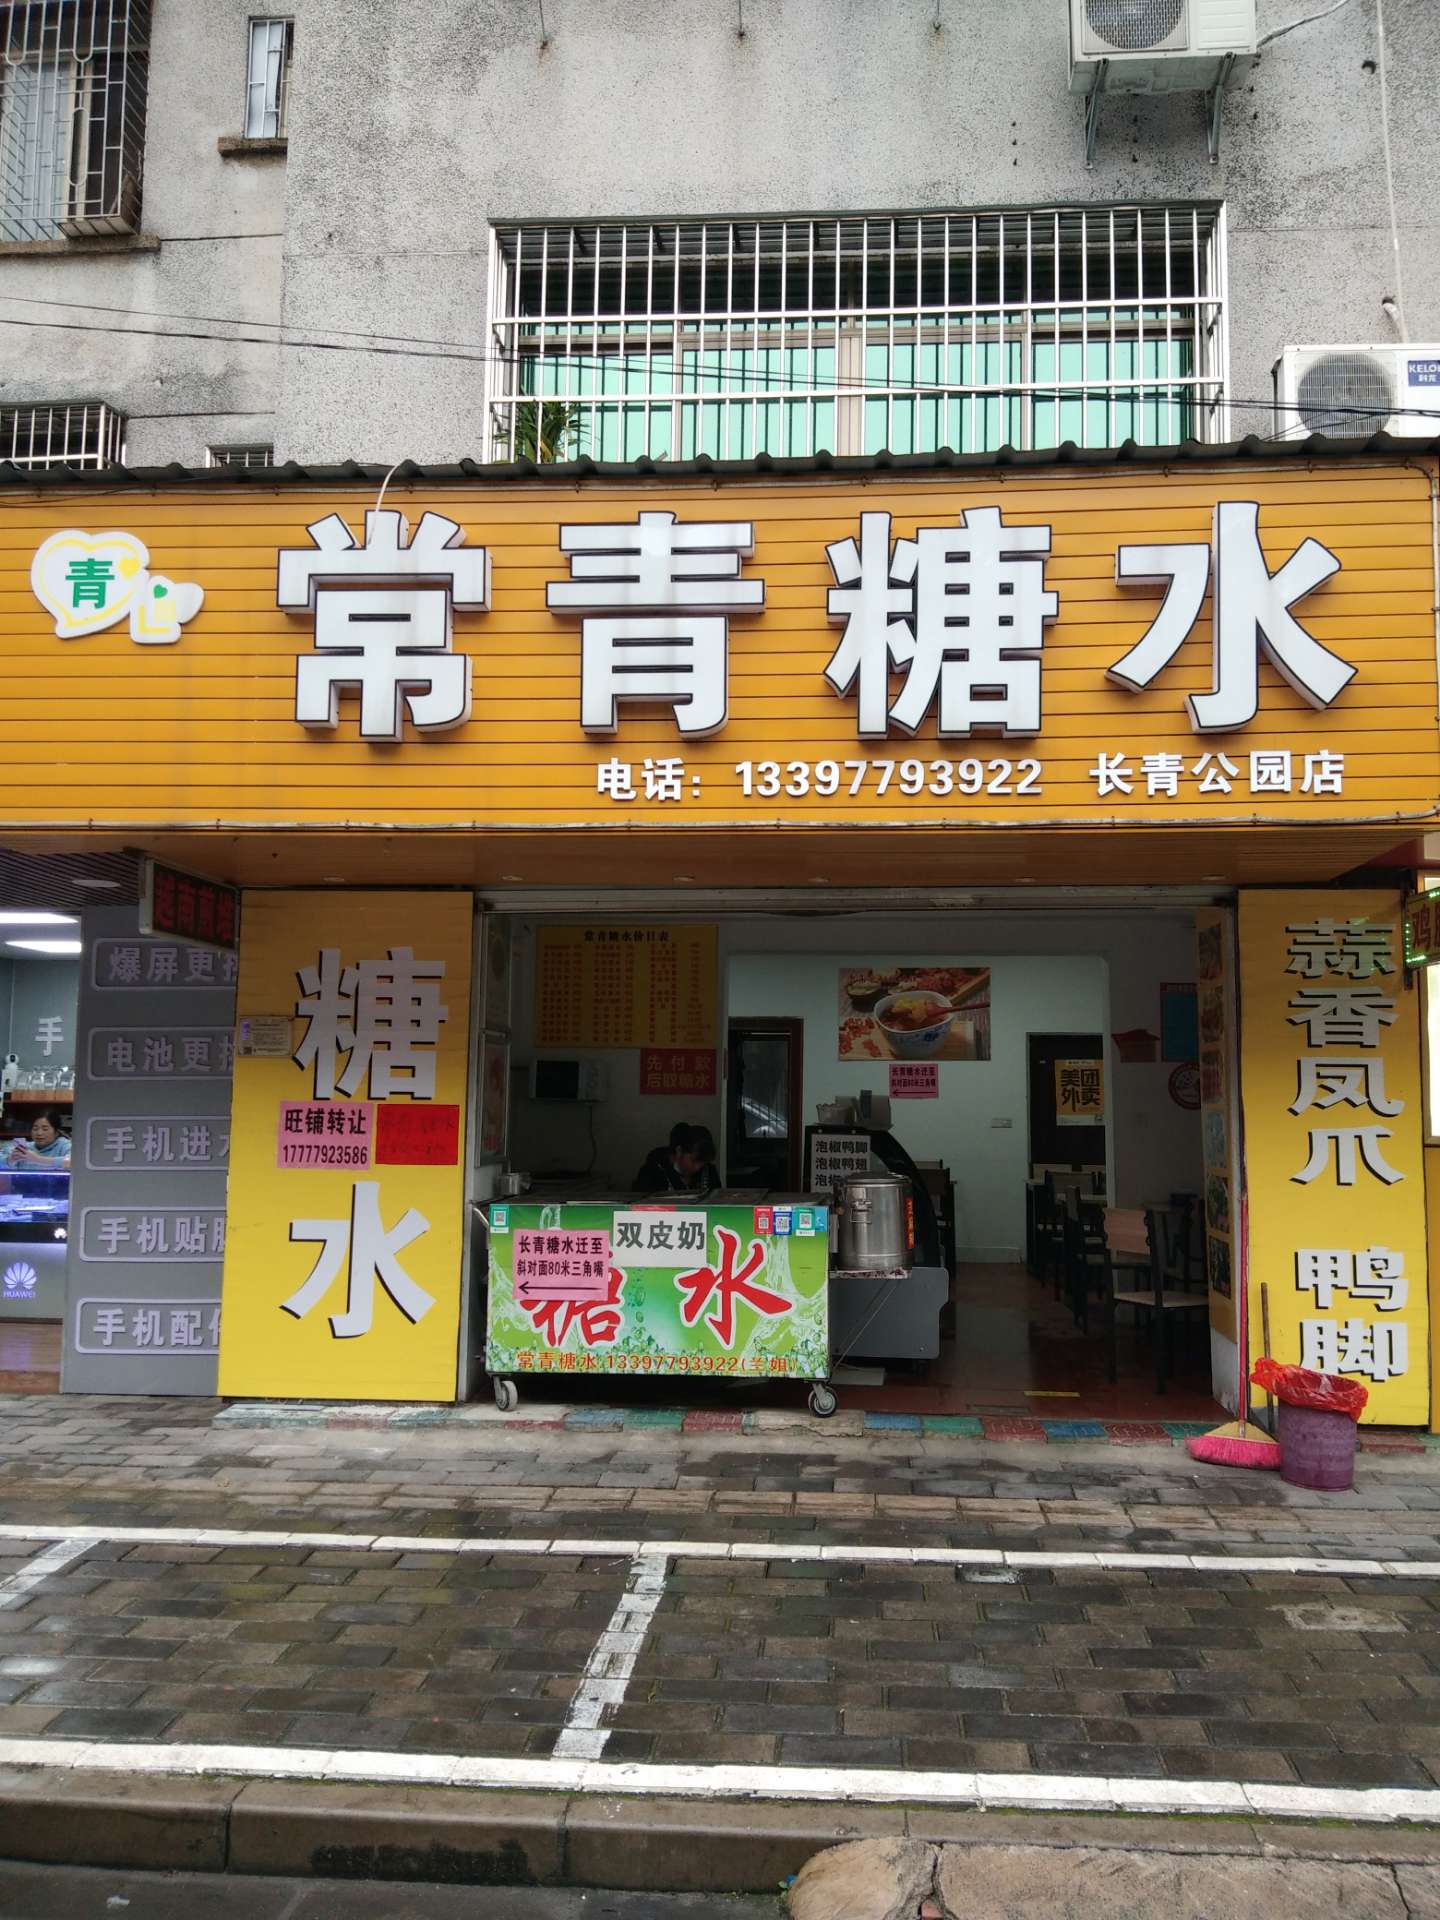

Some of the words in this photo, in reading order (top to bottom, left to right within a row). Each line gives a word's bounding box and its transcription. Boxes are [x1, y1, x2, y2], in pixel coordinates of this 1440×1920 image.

[1409, 364, 1440, 373] KELO
[65, 559, 114, 608] 青
[276, 500, 1360, 744] 常青糖水
[735, 760, 1043, 798] 13397793922
[1089, 751, 1345, 798] 长青公园店
[35, 1016, 64, 1056] 手
[1285, 920, 1405, 1186] 蒜香凤爪
[1060, 1069, 1100, 1087] 美团
[1061, 1087, 1101, 1112] 外卖
[285, 1108, 367, 1135] 旺铺转让
[280, 945, 449, 1339] 糖水
[283, 1145, 368, 1165] 17777923586
[518, 1235, 604, 1255] 长青糖水迁至
[616, 1220, 705, 1251] 双皮奶
[516, 1259, 605, 1278] 斜对面80米三角嘴
[1296, 1244, 1409, 1382] 鸭脚
